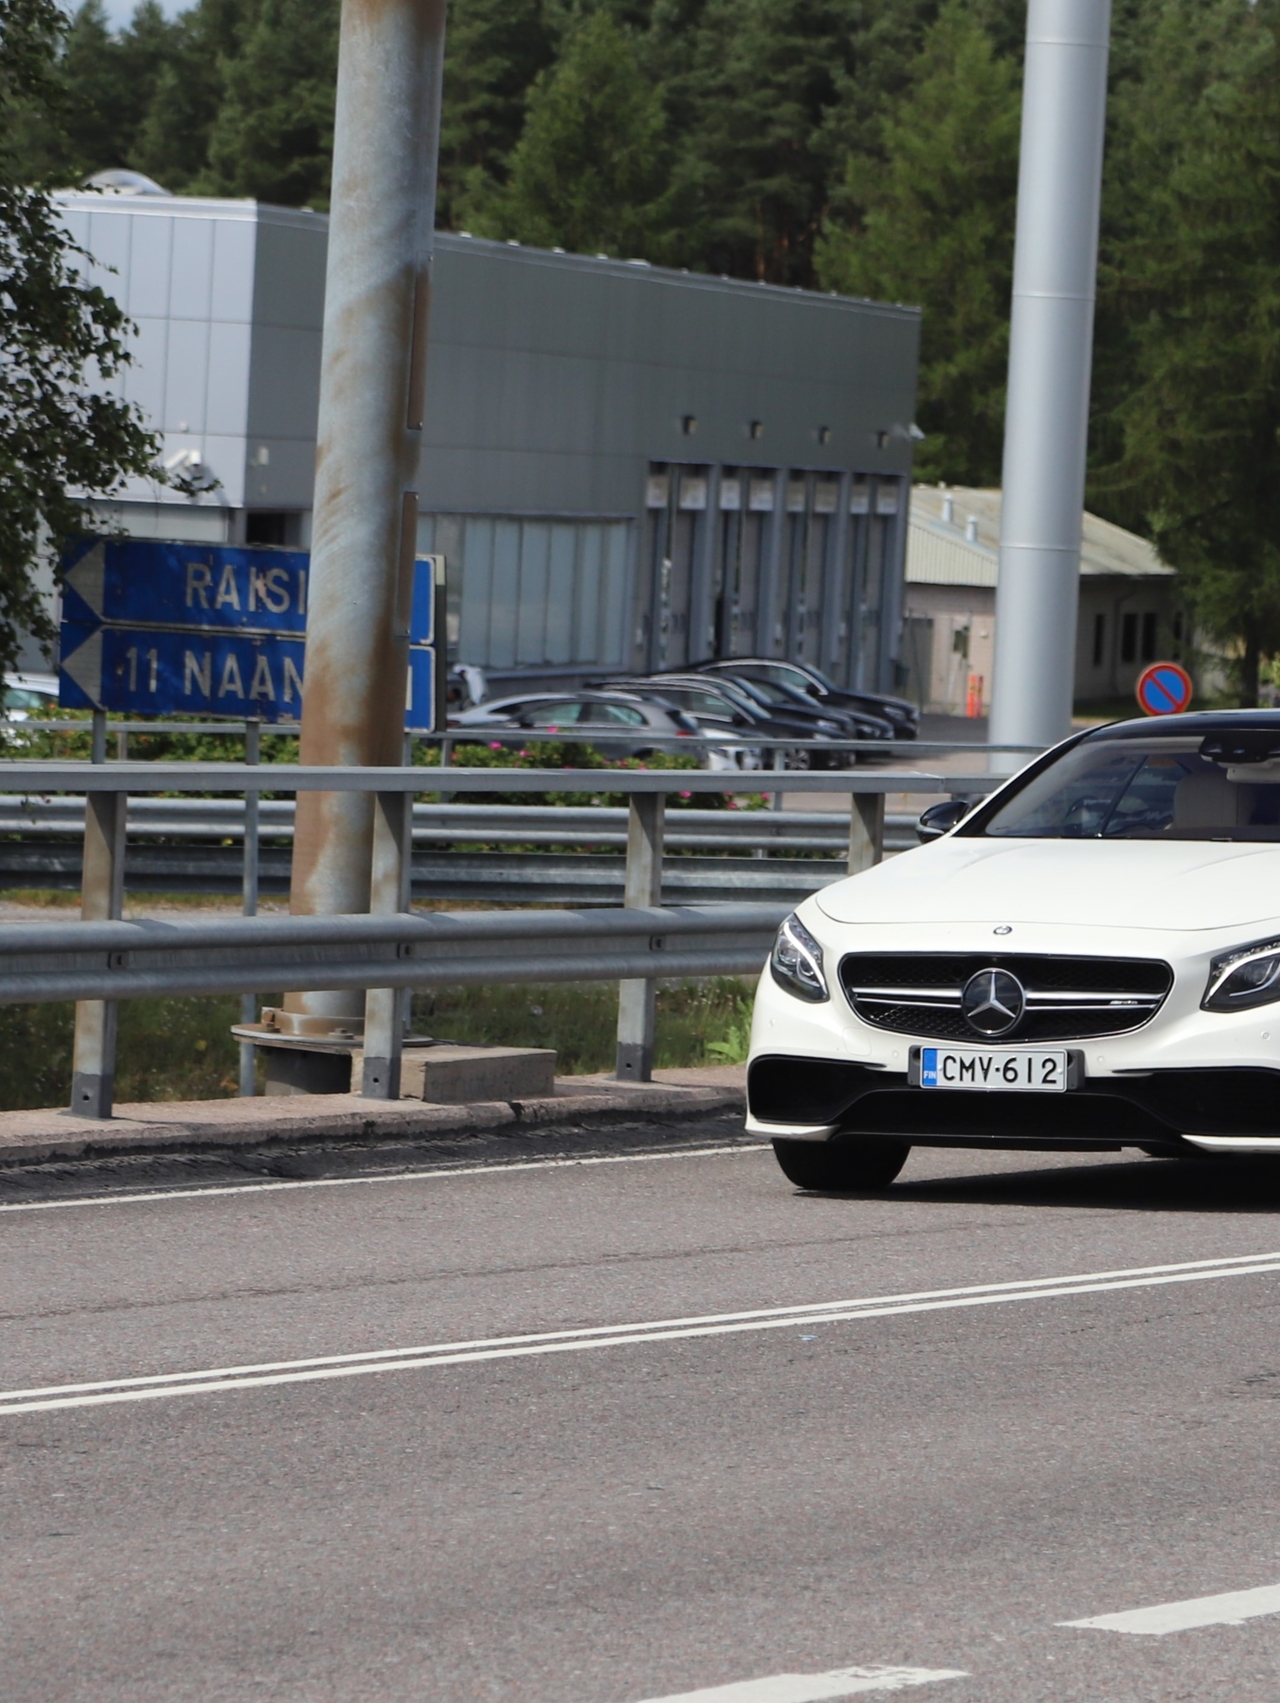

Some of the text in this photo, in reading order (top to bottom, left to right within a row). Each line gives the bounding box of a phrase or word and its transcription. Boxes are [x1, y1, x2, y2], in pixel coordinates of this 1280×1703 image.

[186, 562, 306, 614] RAISI
[126, 647, 157, 693] 11
[923, 1071, 937, 1080] FIN
[942, 1055, 1057, 1084] CMV-612
